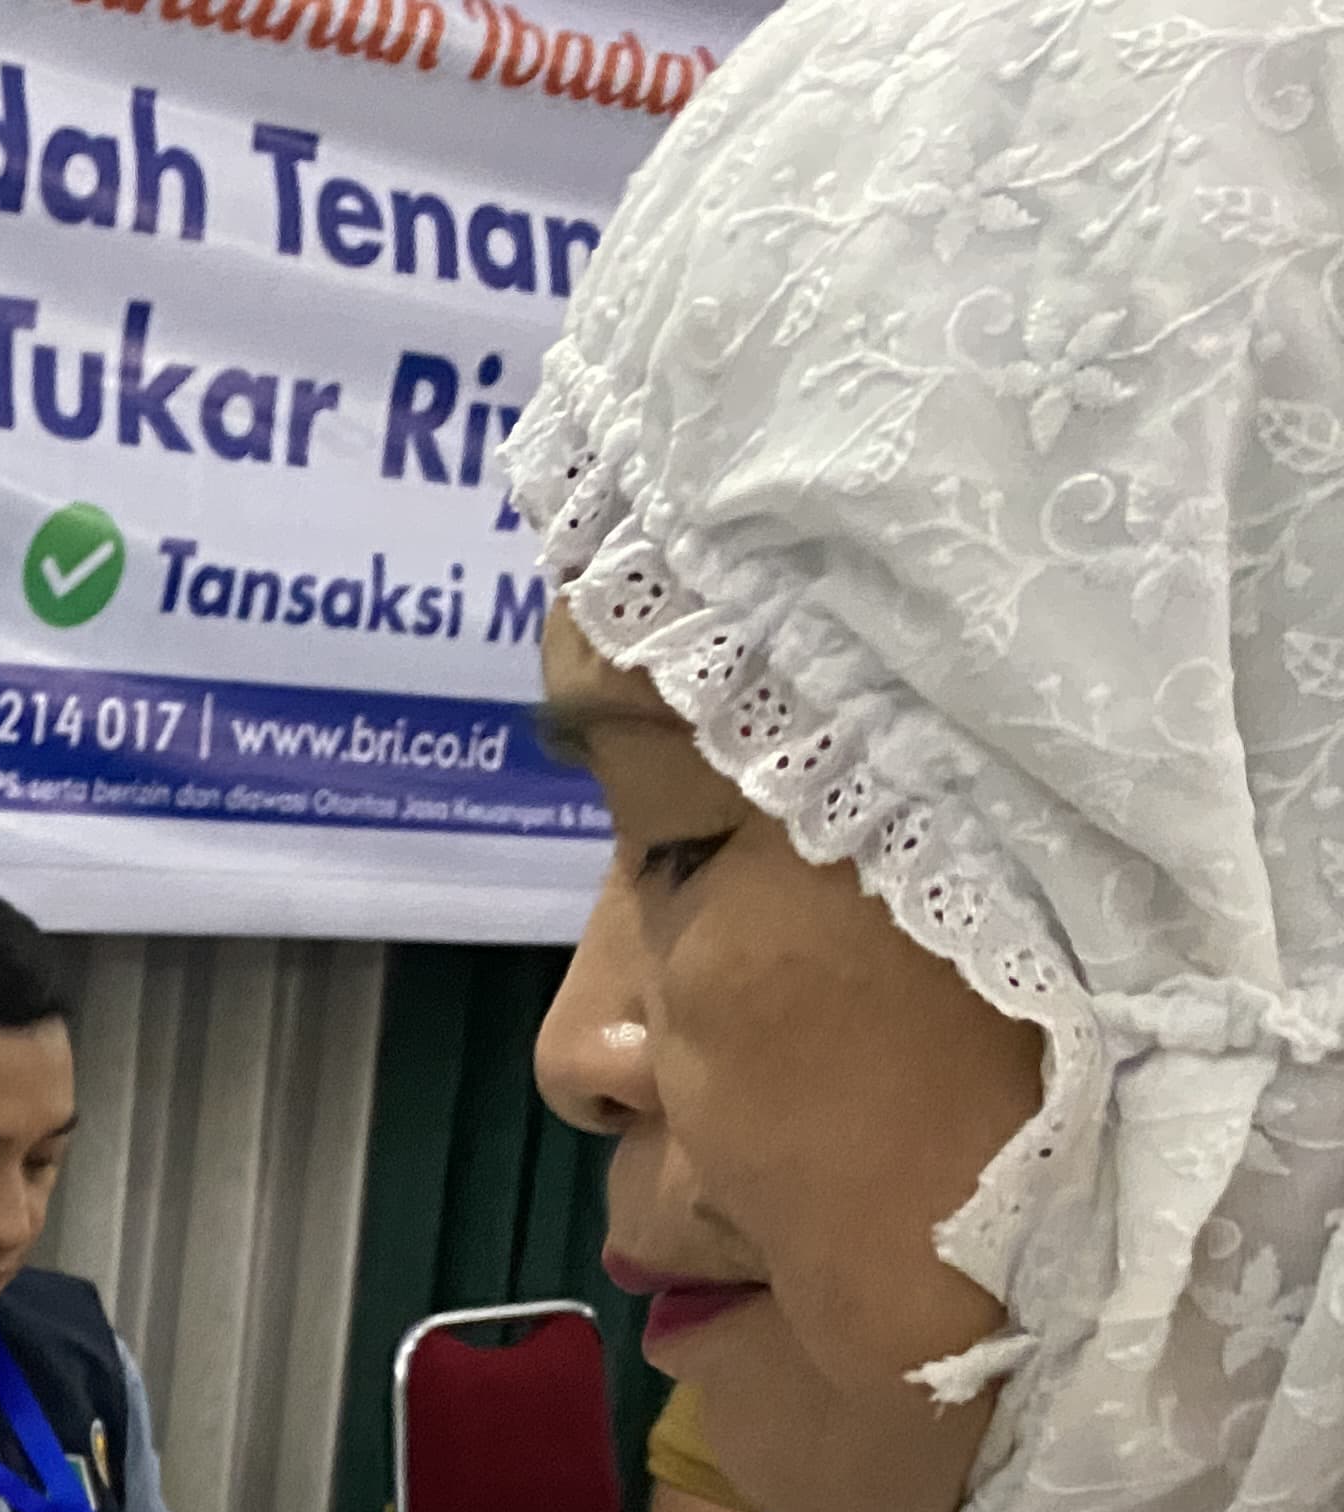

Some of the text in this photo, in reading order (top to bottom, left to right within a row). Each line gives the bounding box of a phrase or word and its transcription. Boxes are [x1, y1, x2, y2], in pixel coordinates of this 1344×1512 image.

[464, 0, 715, 123] Ibada
[159, 537, 465, 639] Tansaksi
[95, 697, 186, 753] 017
[231, 714, 508, 772] www.bri.co.id
